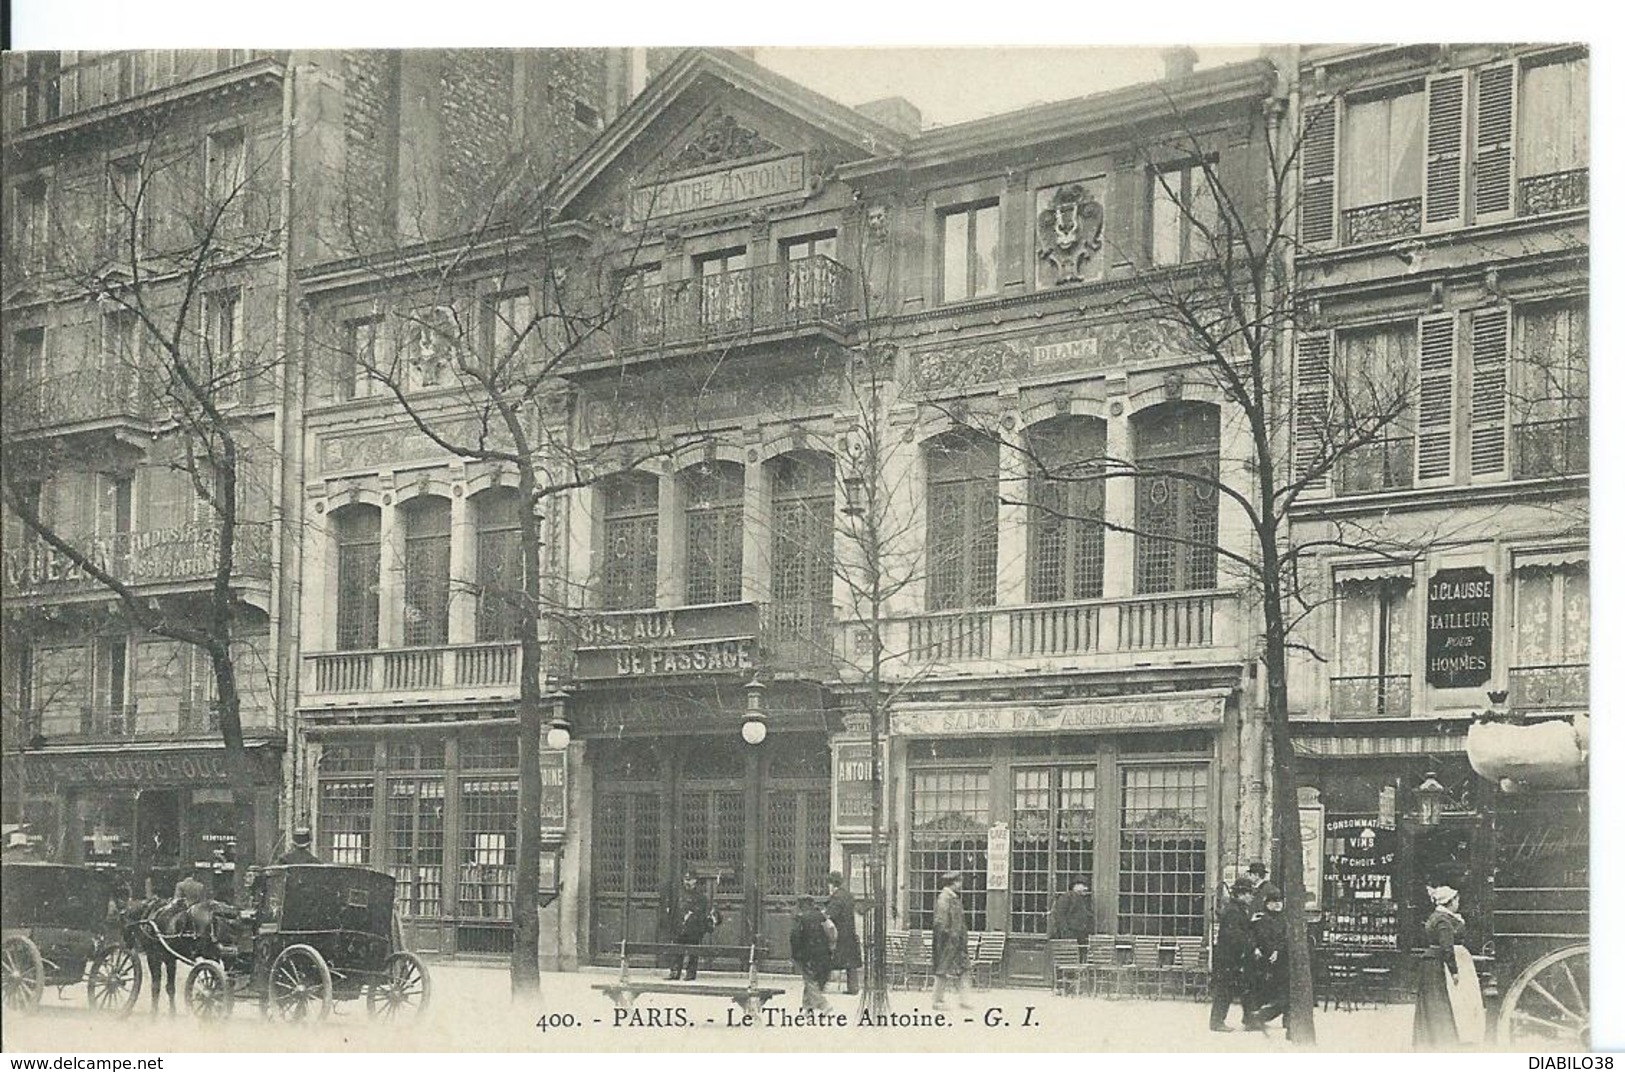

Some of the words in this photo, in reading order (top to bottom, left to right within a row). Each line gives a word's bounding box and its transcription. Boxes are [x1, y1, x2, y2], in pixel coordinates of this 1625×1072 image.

[719, 160, 800, 201] ANTOINE
[1430, 611, 1491, 630] TAILLEUR
[617, 650, 645, 674] DE
[651, 641, 753, 673] PASSAGE
[1431, 655, 1487, 671] HOMMES
[943, 709, 1000, 729] SALON
[838, 761, 883, 781] ANTOIE
[1326, 819, 1396, 831] CONSOMMATI
[1349, 837, 1375, 848] VINS
